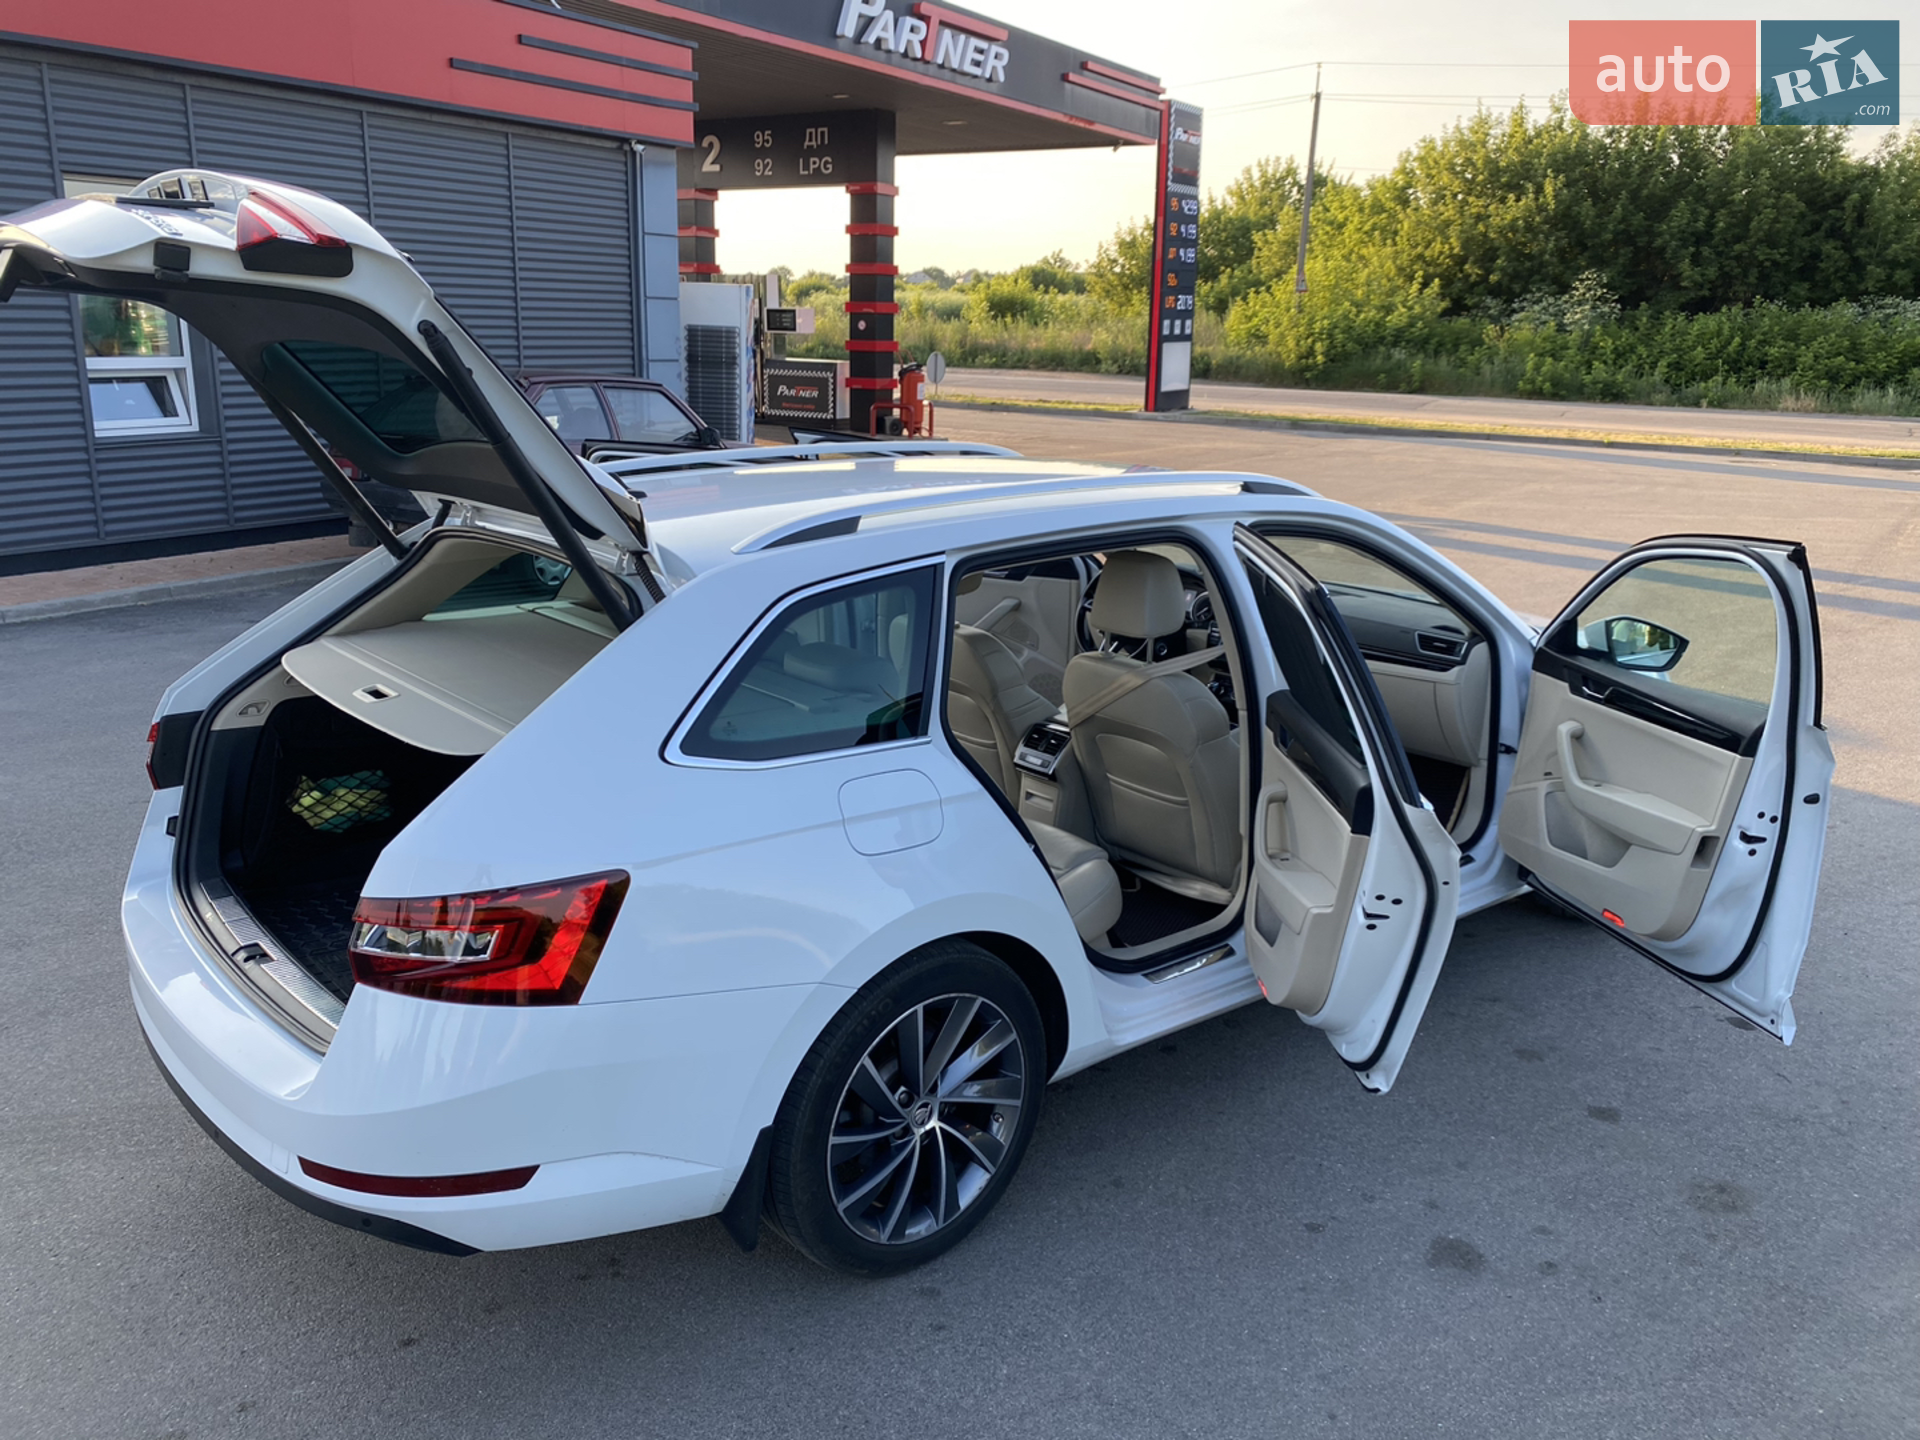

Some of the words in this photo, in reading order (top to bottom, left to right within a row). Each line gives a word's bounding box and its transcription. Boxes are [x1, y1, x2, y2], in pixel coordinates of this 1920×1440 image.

[836, 0, 1010, 83] PARTNER
[754, 130, 773, 148] 95
[804, 127, 828, 149] ДП
[701, 134, 721, 172] 2
[754, 158, 773, 176] 92
[799, 156, 833, 174] LPG
[777, 384, 819, 398] PARTNER
